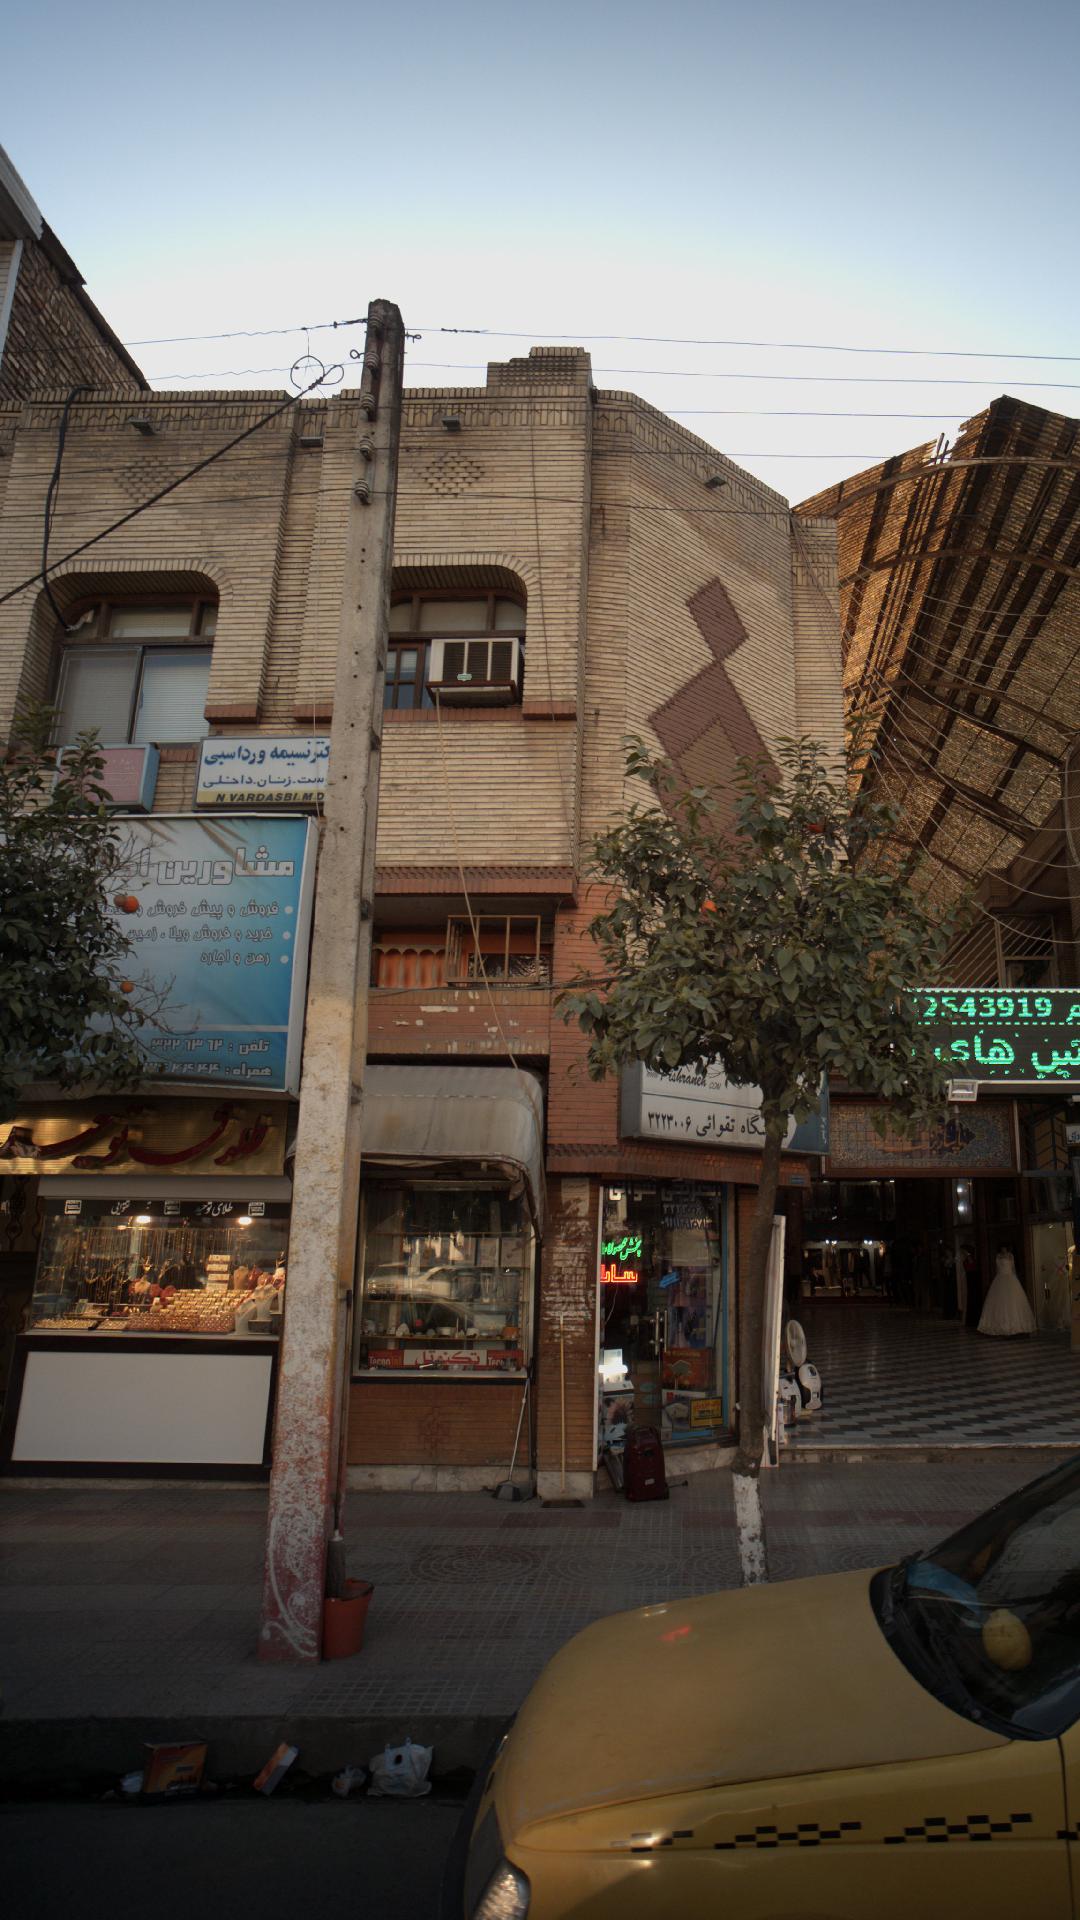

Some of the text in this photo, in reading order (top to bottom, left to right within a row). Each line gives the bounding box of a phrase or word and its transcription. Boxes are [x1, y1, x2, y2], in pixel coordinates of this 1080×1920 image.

[156, 846, 295, 885] مشاورین
[146, 899, 187, 917] فروش
[191, 899, 224, 920] پیش
[227, 904, 236, 917] و
[240, 899, 279, 917] فروش
[193, 924, 231, 942] فروش
[234, 930, 243, 942] و
[245, 926, 273, 942] خرید
[200, 949, 271, 965] رهن و اجاره
[922, 996, 1053, 1018] 2543919
[238, 1038, 271, 1055] تلفن
